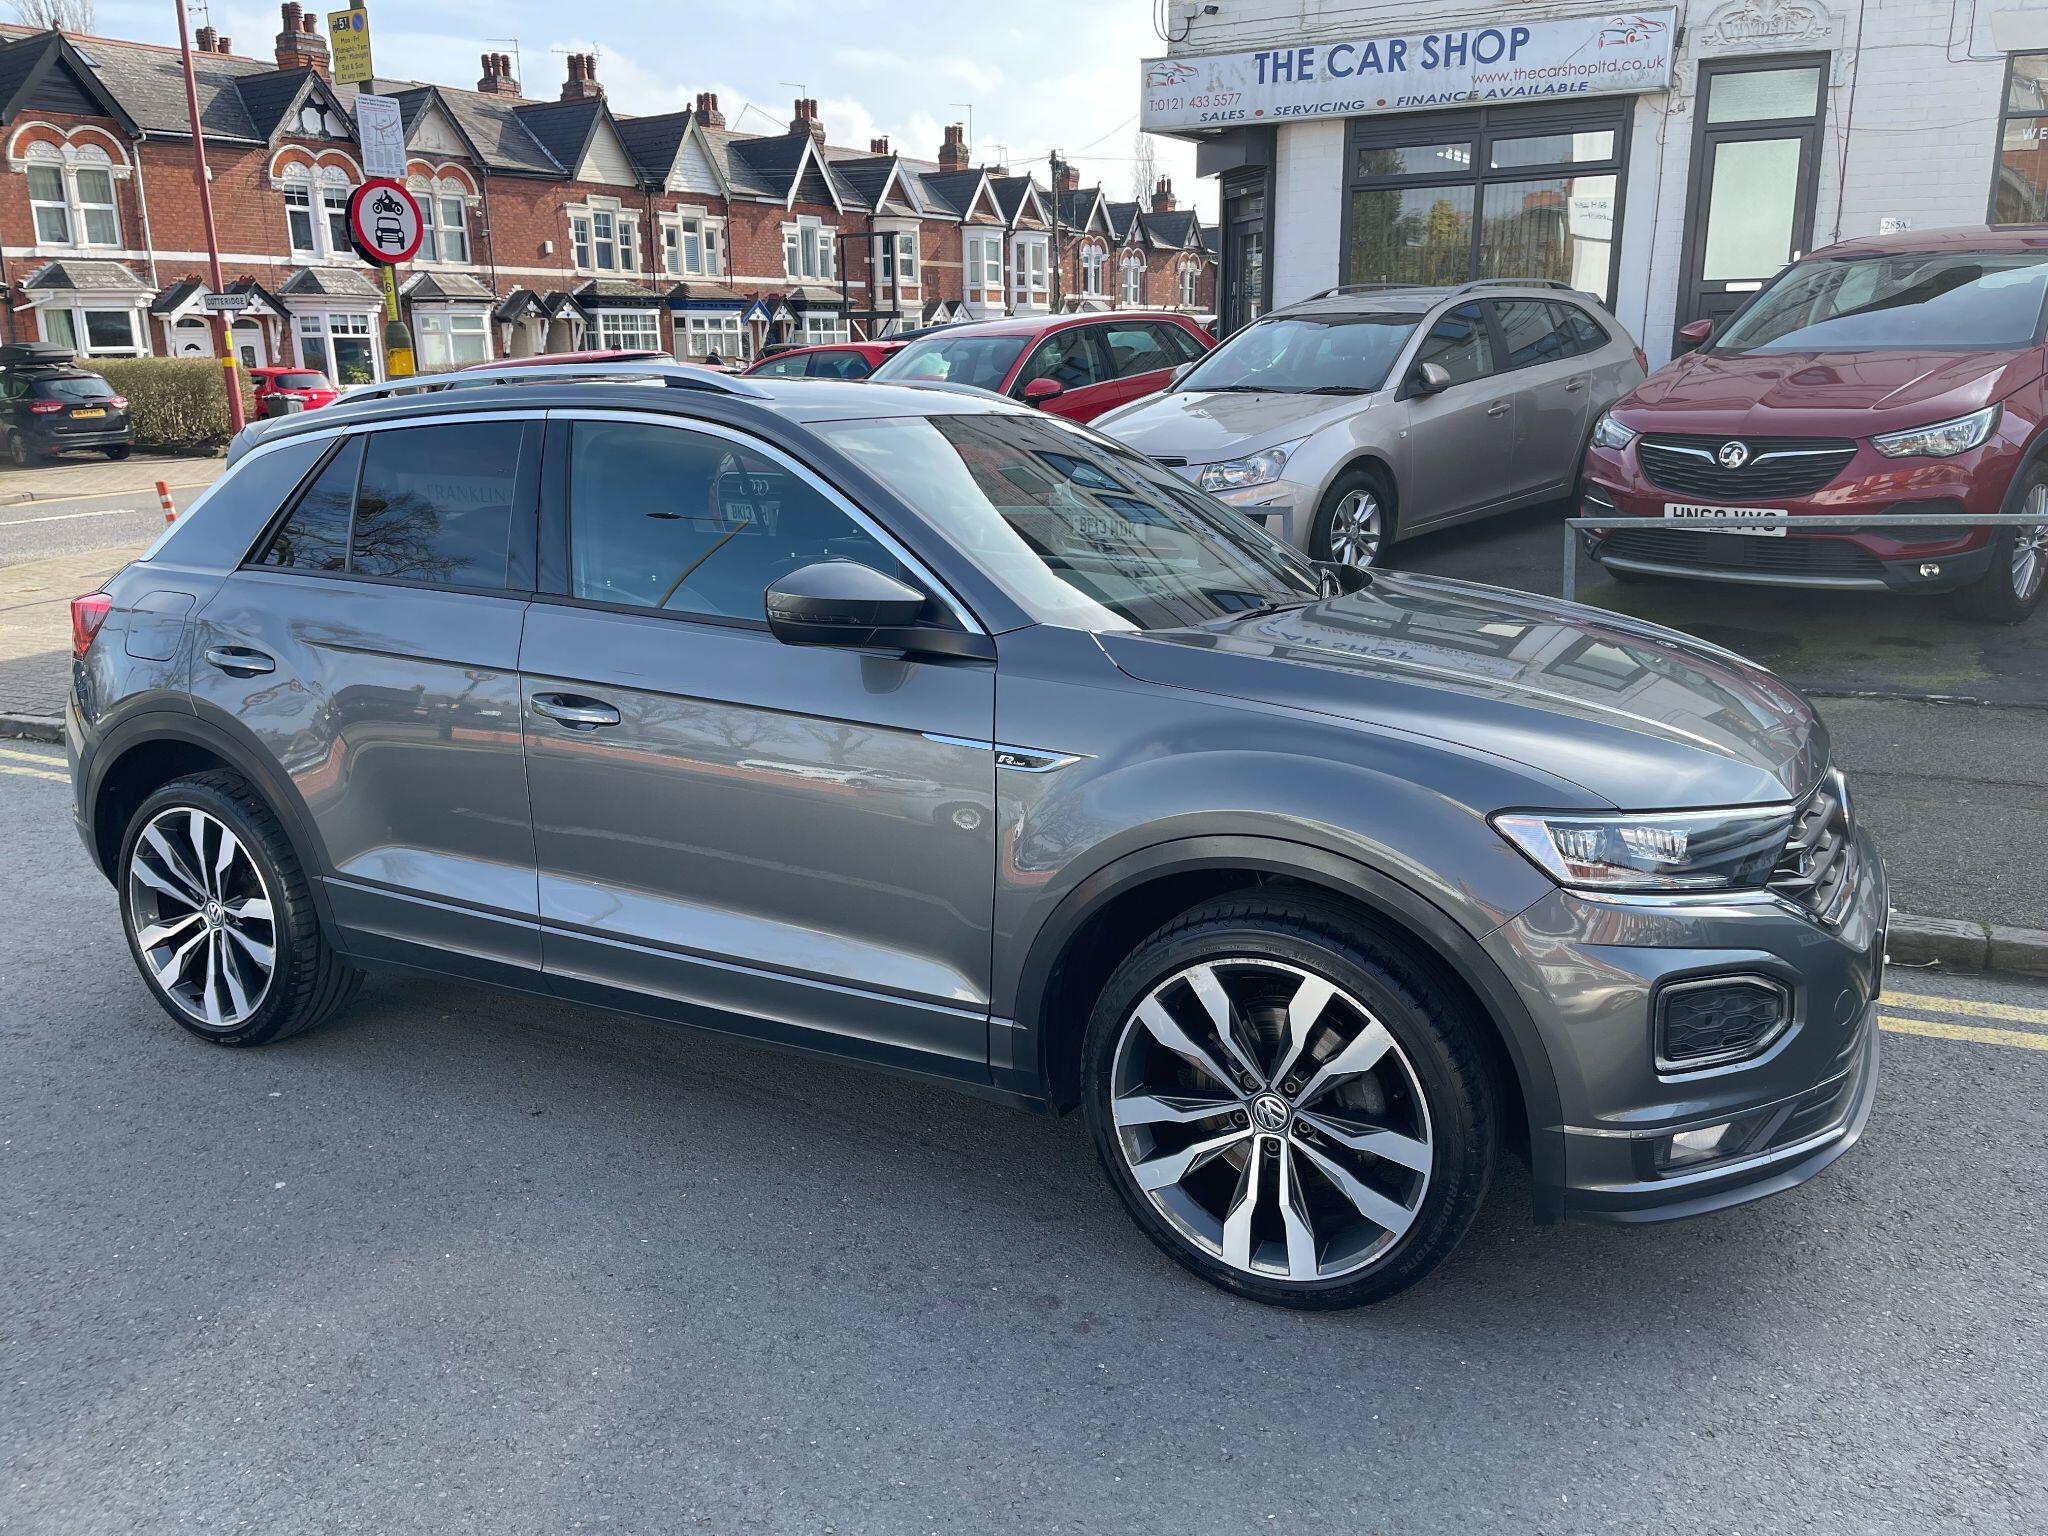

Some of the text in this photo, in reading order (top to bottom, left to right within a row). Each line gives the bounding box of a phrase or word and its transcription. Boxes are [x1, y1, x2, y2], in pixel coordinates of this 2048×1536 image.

[1254, 27, 1530, 84] THE CAR SHOP
[1472, 55, 1665, 84] www.thecarshopltd.co.uk
[1189, 96, 1209, 108] 433
[1213, 93, 1242, 107] 5577
[1200, 81, 1589, 121] SALES SERVICING FINANCE AVAILABLE
[207, 297, 245, 306] COTTERIDGE
